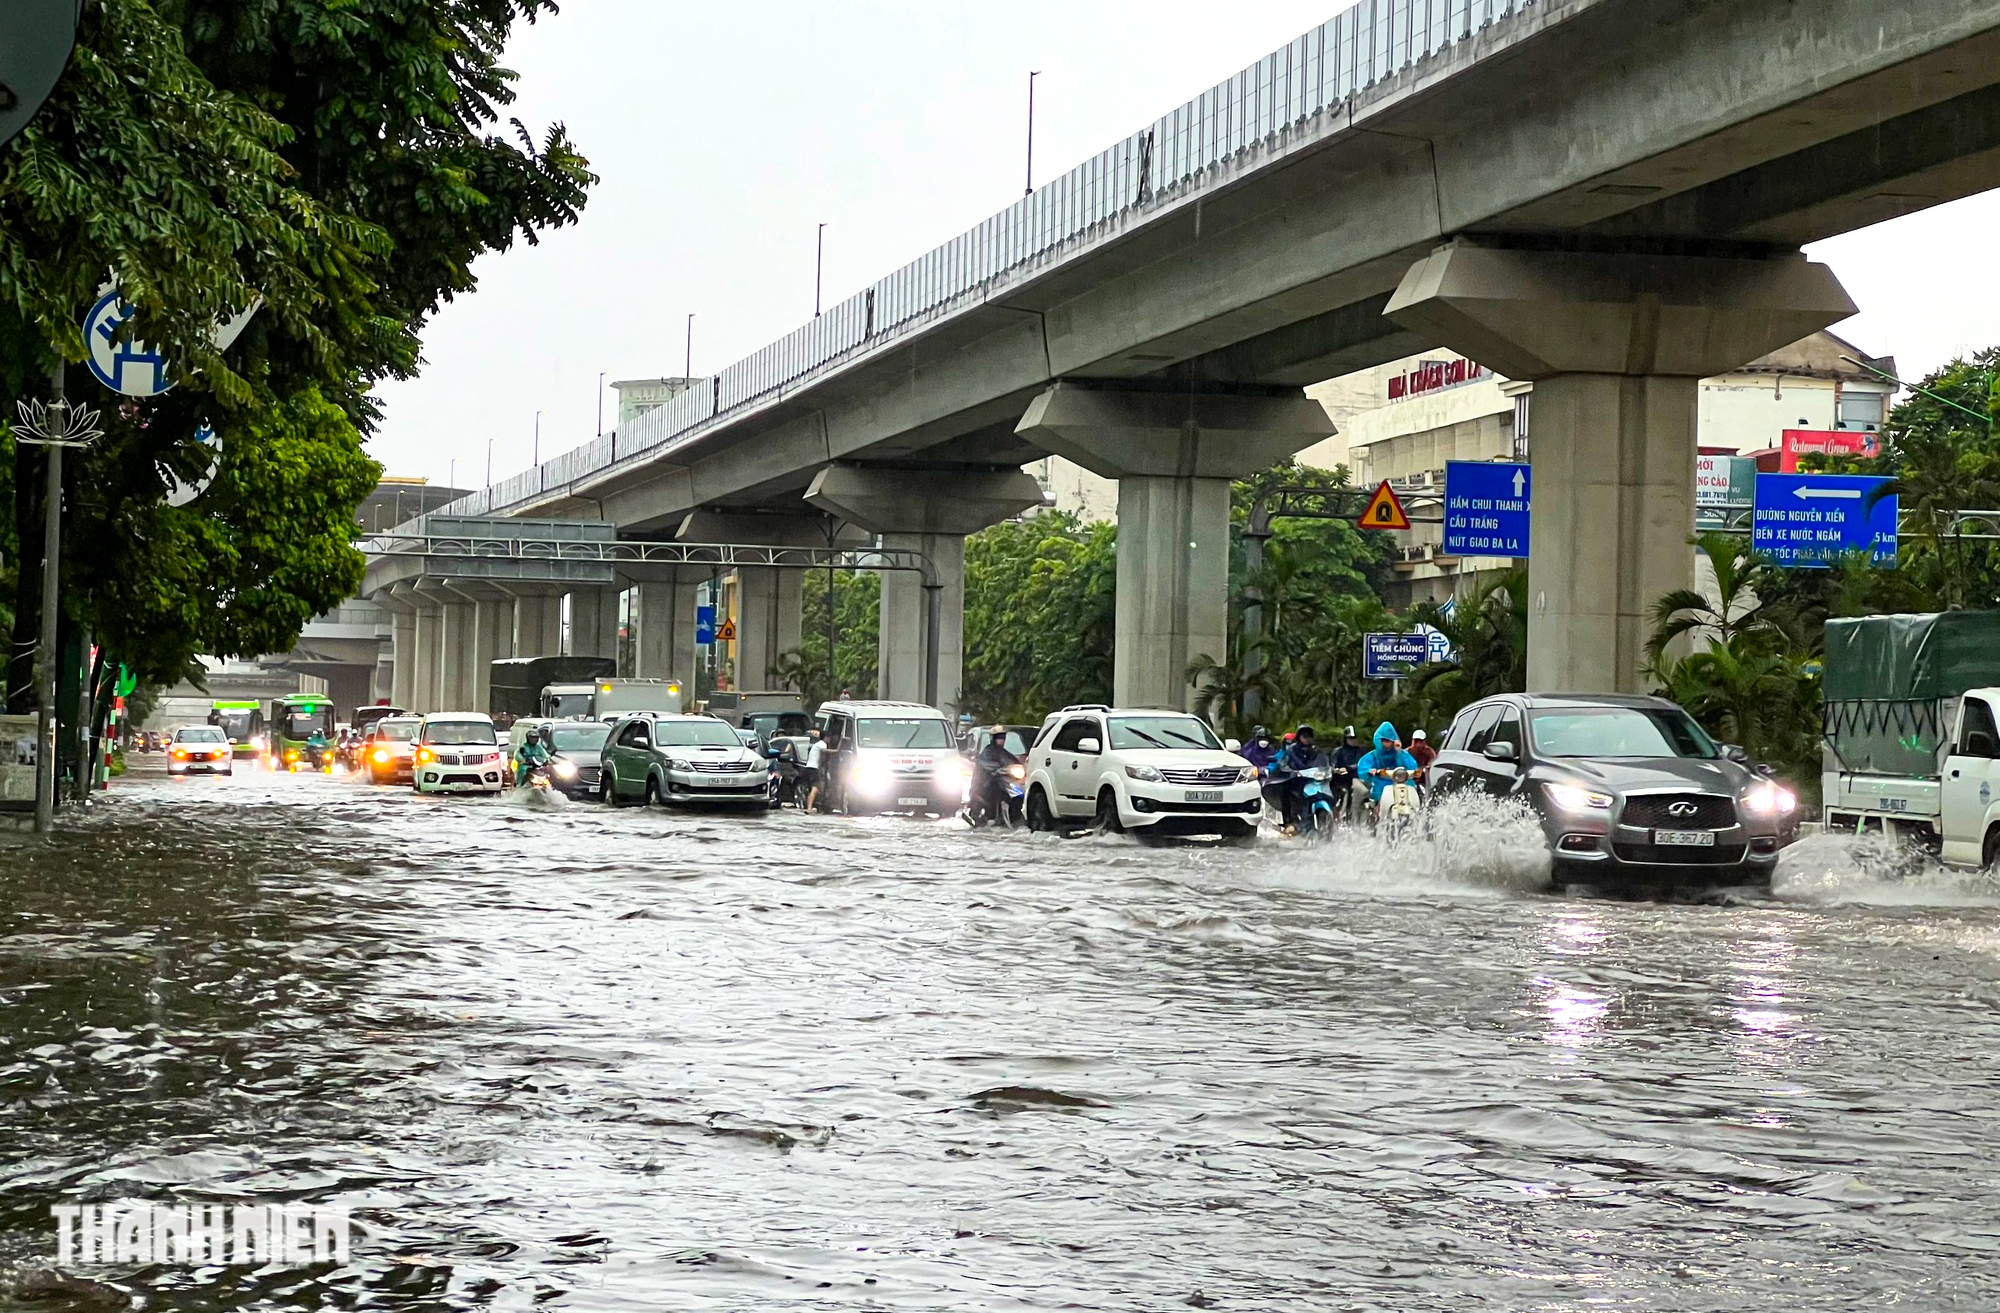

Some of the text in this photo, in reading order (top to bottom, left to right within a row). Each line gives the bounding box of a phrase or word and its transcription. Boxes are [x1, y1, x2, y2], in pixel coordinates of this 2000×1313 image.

[1711, 475, 1727, 487] CÁO
[1472, 499, 1492, 510] CHUI
[1495, 500, 1523, 511] THANH
[1756, 507, 1786, 521] ĐƯỜNG
[1756, 526, 1773, 540] BẾN
[1776, 529, 1787, 540] XE
[1790, 527, 1814, 540] NƯỚC
[1875, 532, 1881, 542] 5
[1882, 532, 1896, 543] km
[1449, 534, 1518, 549] NÚT GIAO BA LA
[1873, 550, 1879, 561] 6
